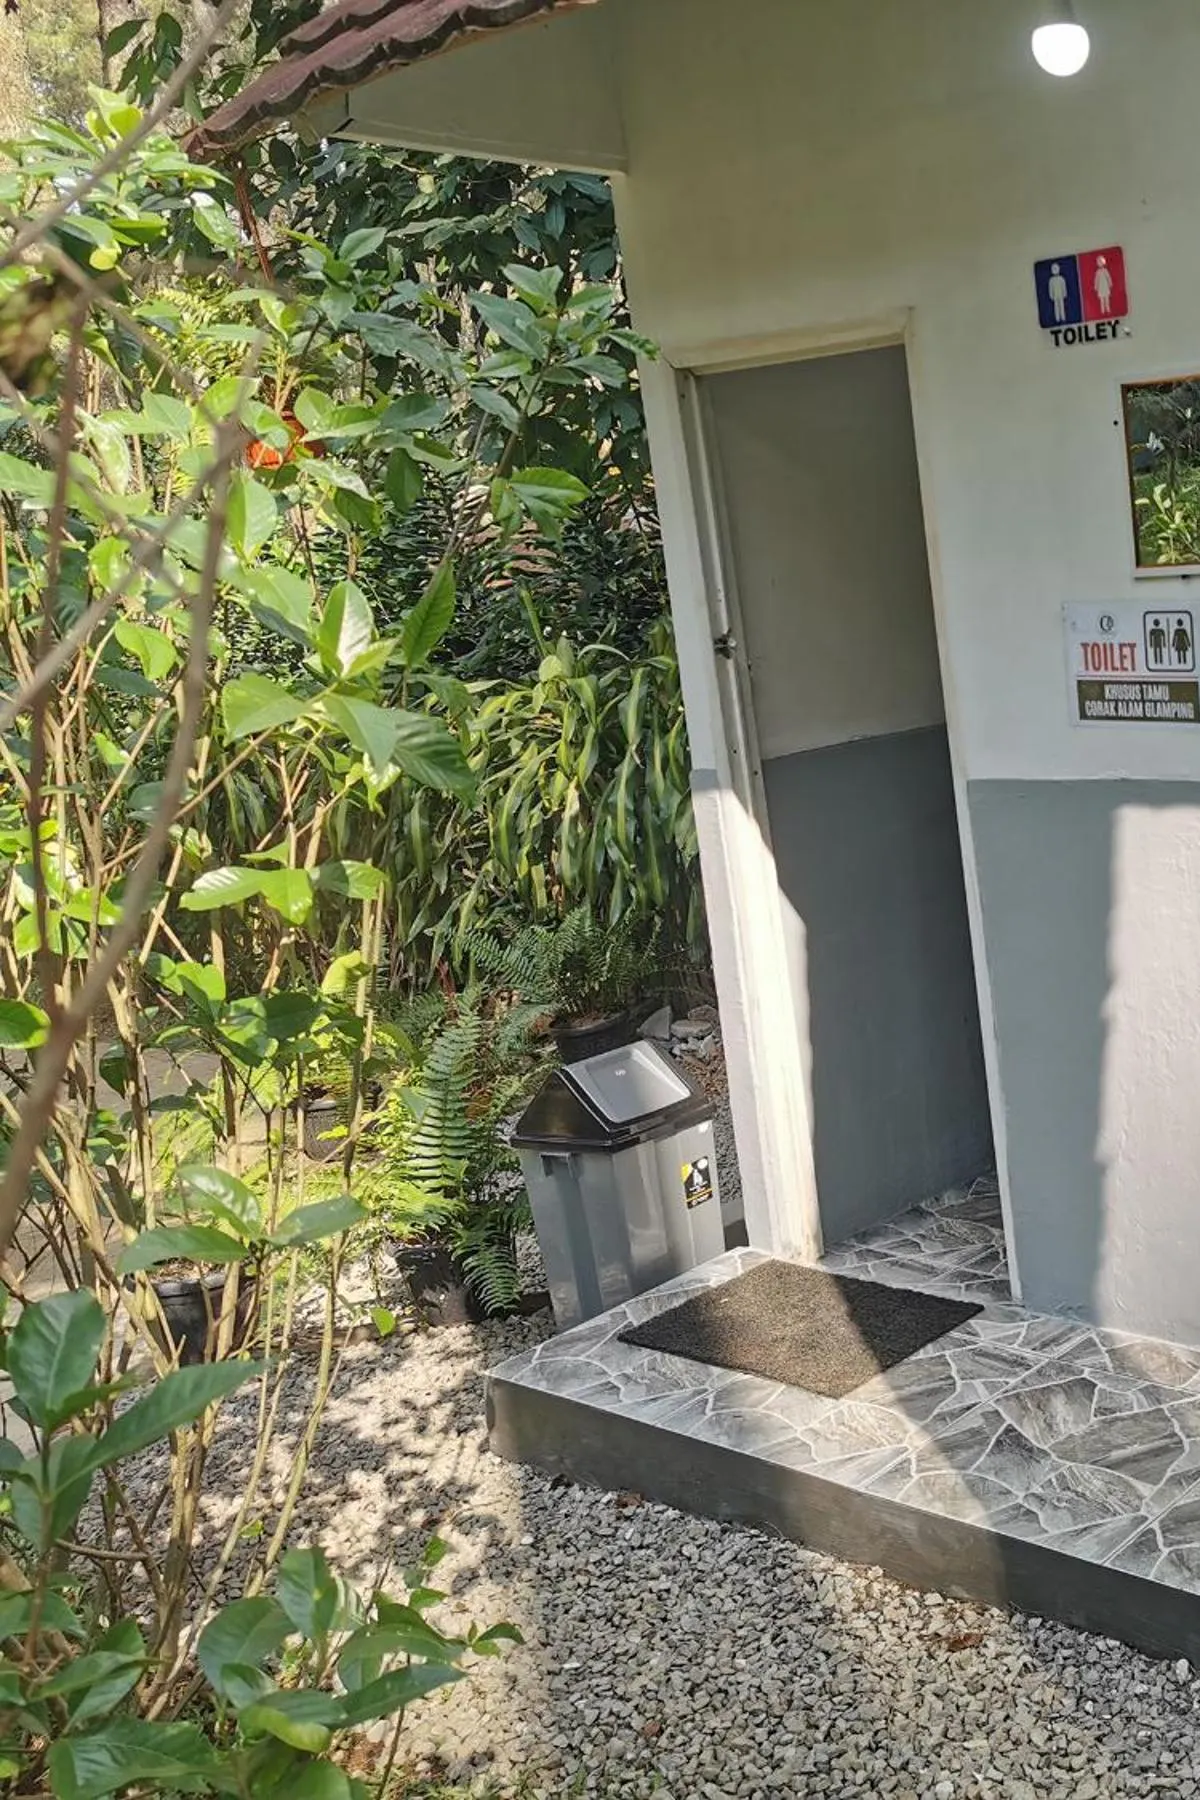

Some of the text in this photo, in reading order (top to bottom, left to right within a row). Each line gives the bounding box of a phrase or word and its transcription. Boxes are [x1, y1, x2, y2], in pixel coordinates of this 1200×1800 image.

[1080, 642, 1137, 672] TOILET
[1103, 684, 1169, 701] KHUSUS TAMU
[1084, 700, 1195, 719] CORAK ALAM GLAMPING
